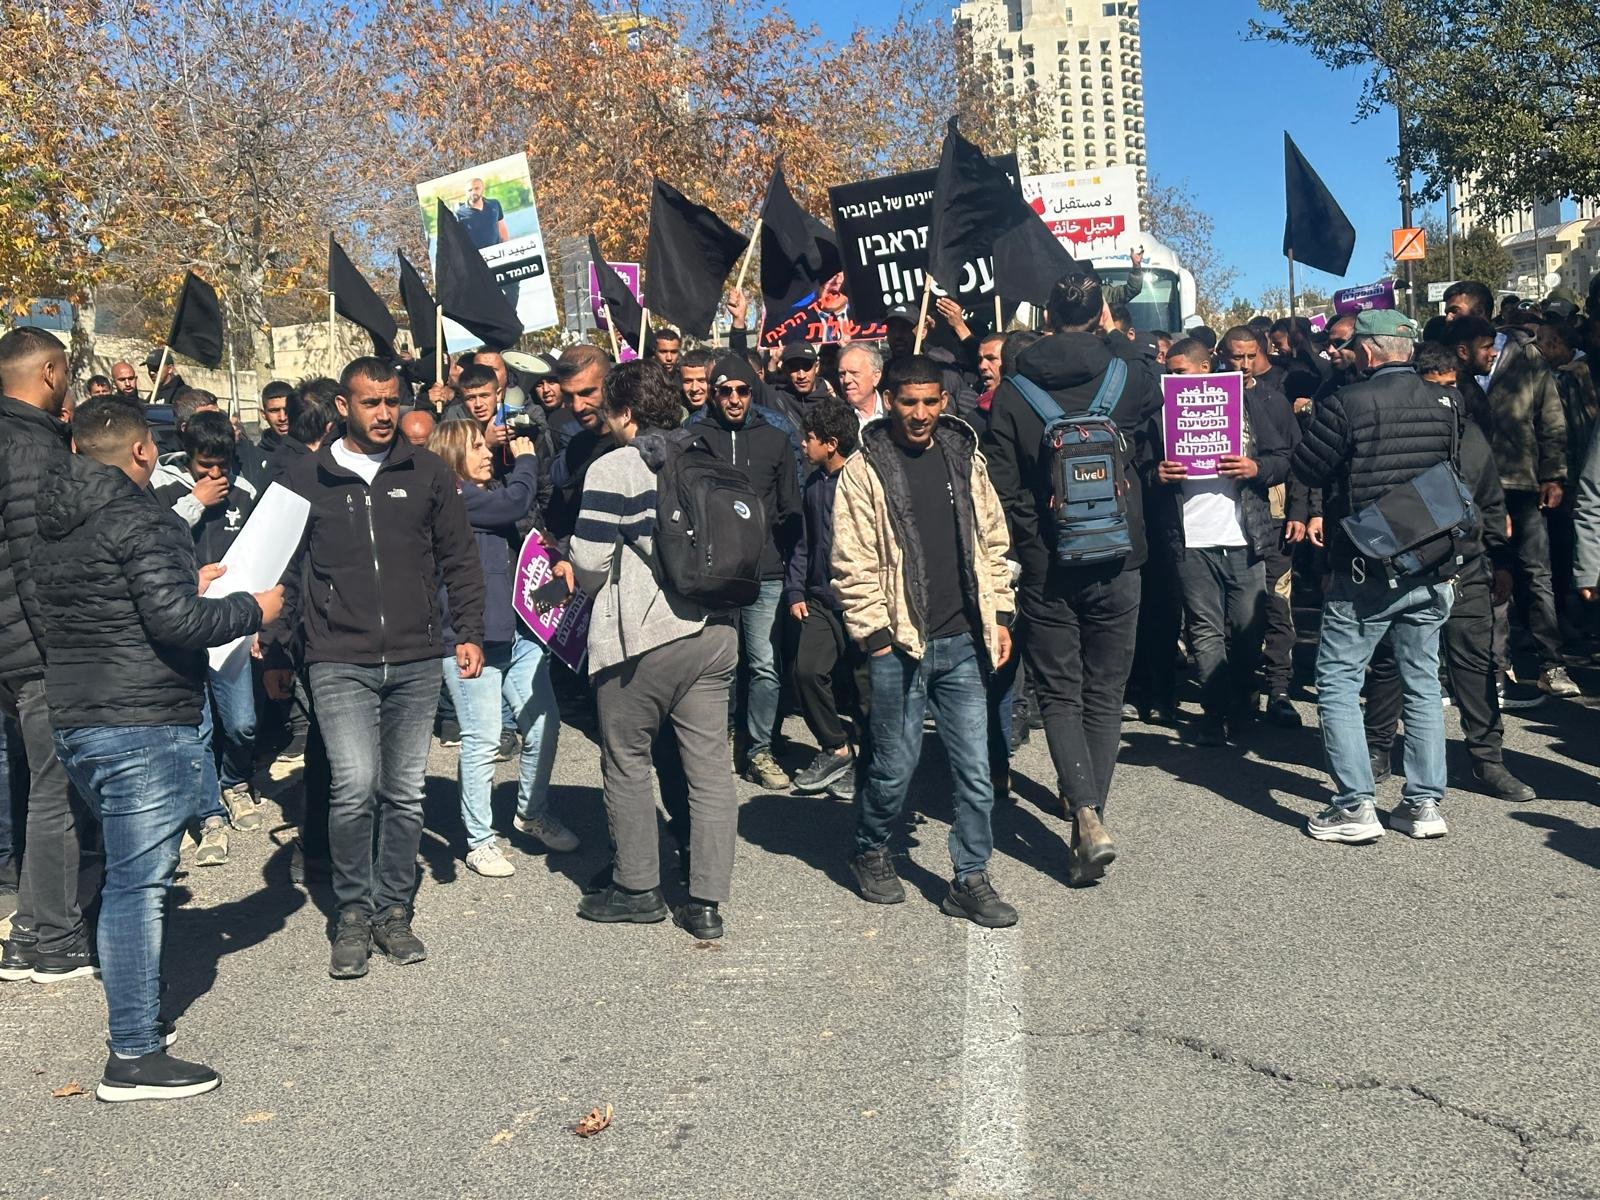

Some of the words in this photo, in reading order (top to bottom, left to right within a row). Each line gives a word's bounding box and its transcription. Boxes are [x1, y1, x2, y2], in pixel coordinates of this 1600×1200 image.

[883, 194, 902, 211] של
[905, 190, 935, 208] יינים
[1104, 194, 1112, 206] لا
[838, 202, 867, 219] גביר
[868, 200, 883, 218] בן
[506, 263, 540, 278] מחמד
[765, 311, 808, 343] הרצח
[1178, 395, 1196, 404] נגד
[1198, 394, 1227, 404] ביחד
[1181, 405, 1224, 419] الجريمة
[1179, 419, 1226, 428] הפשיעה
[1177, 443, 1229, 455] וההפקרה
[1074, 468, 1105, 481] LiveU
